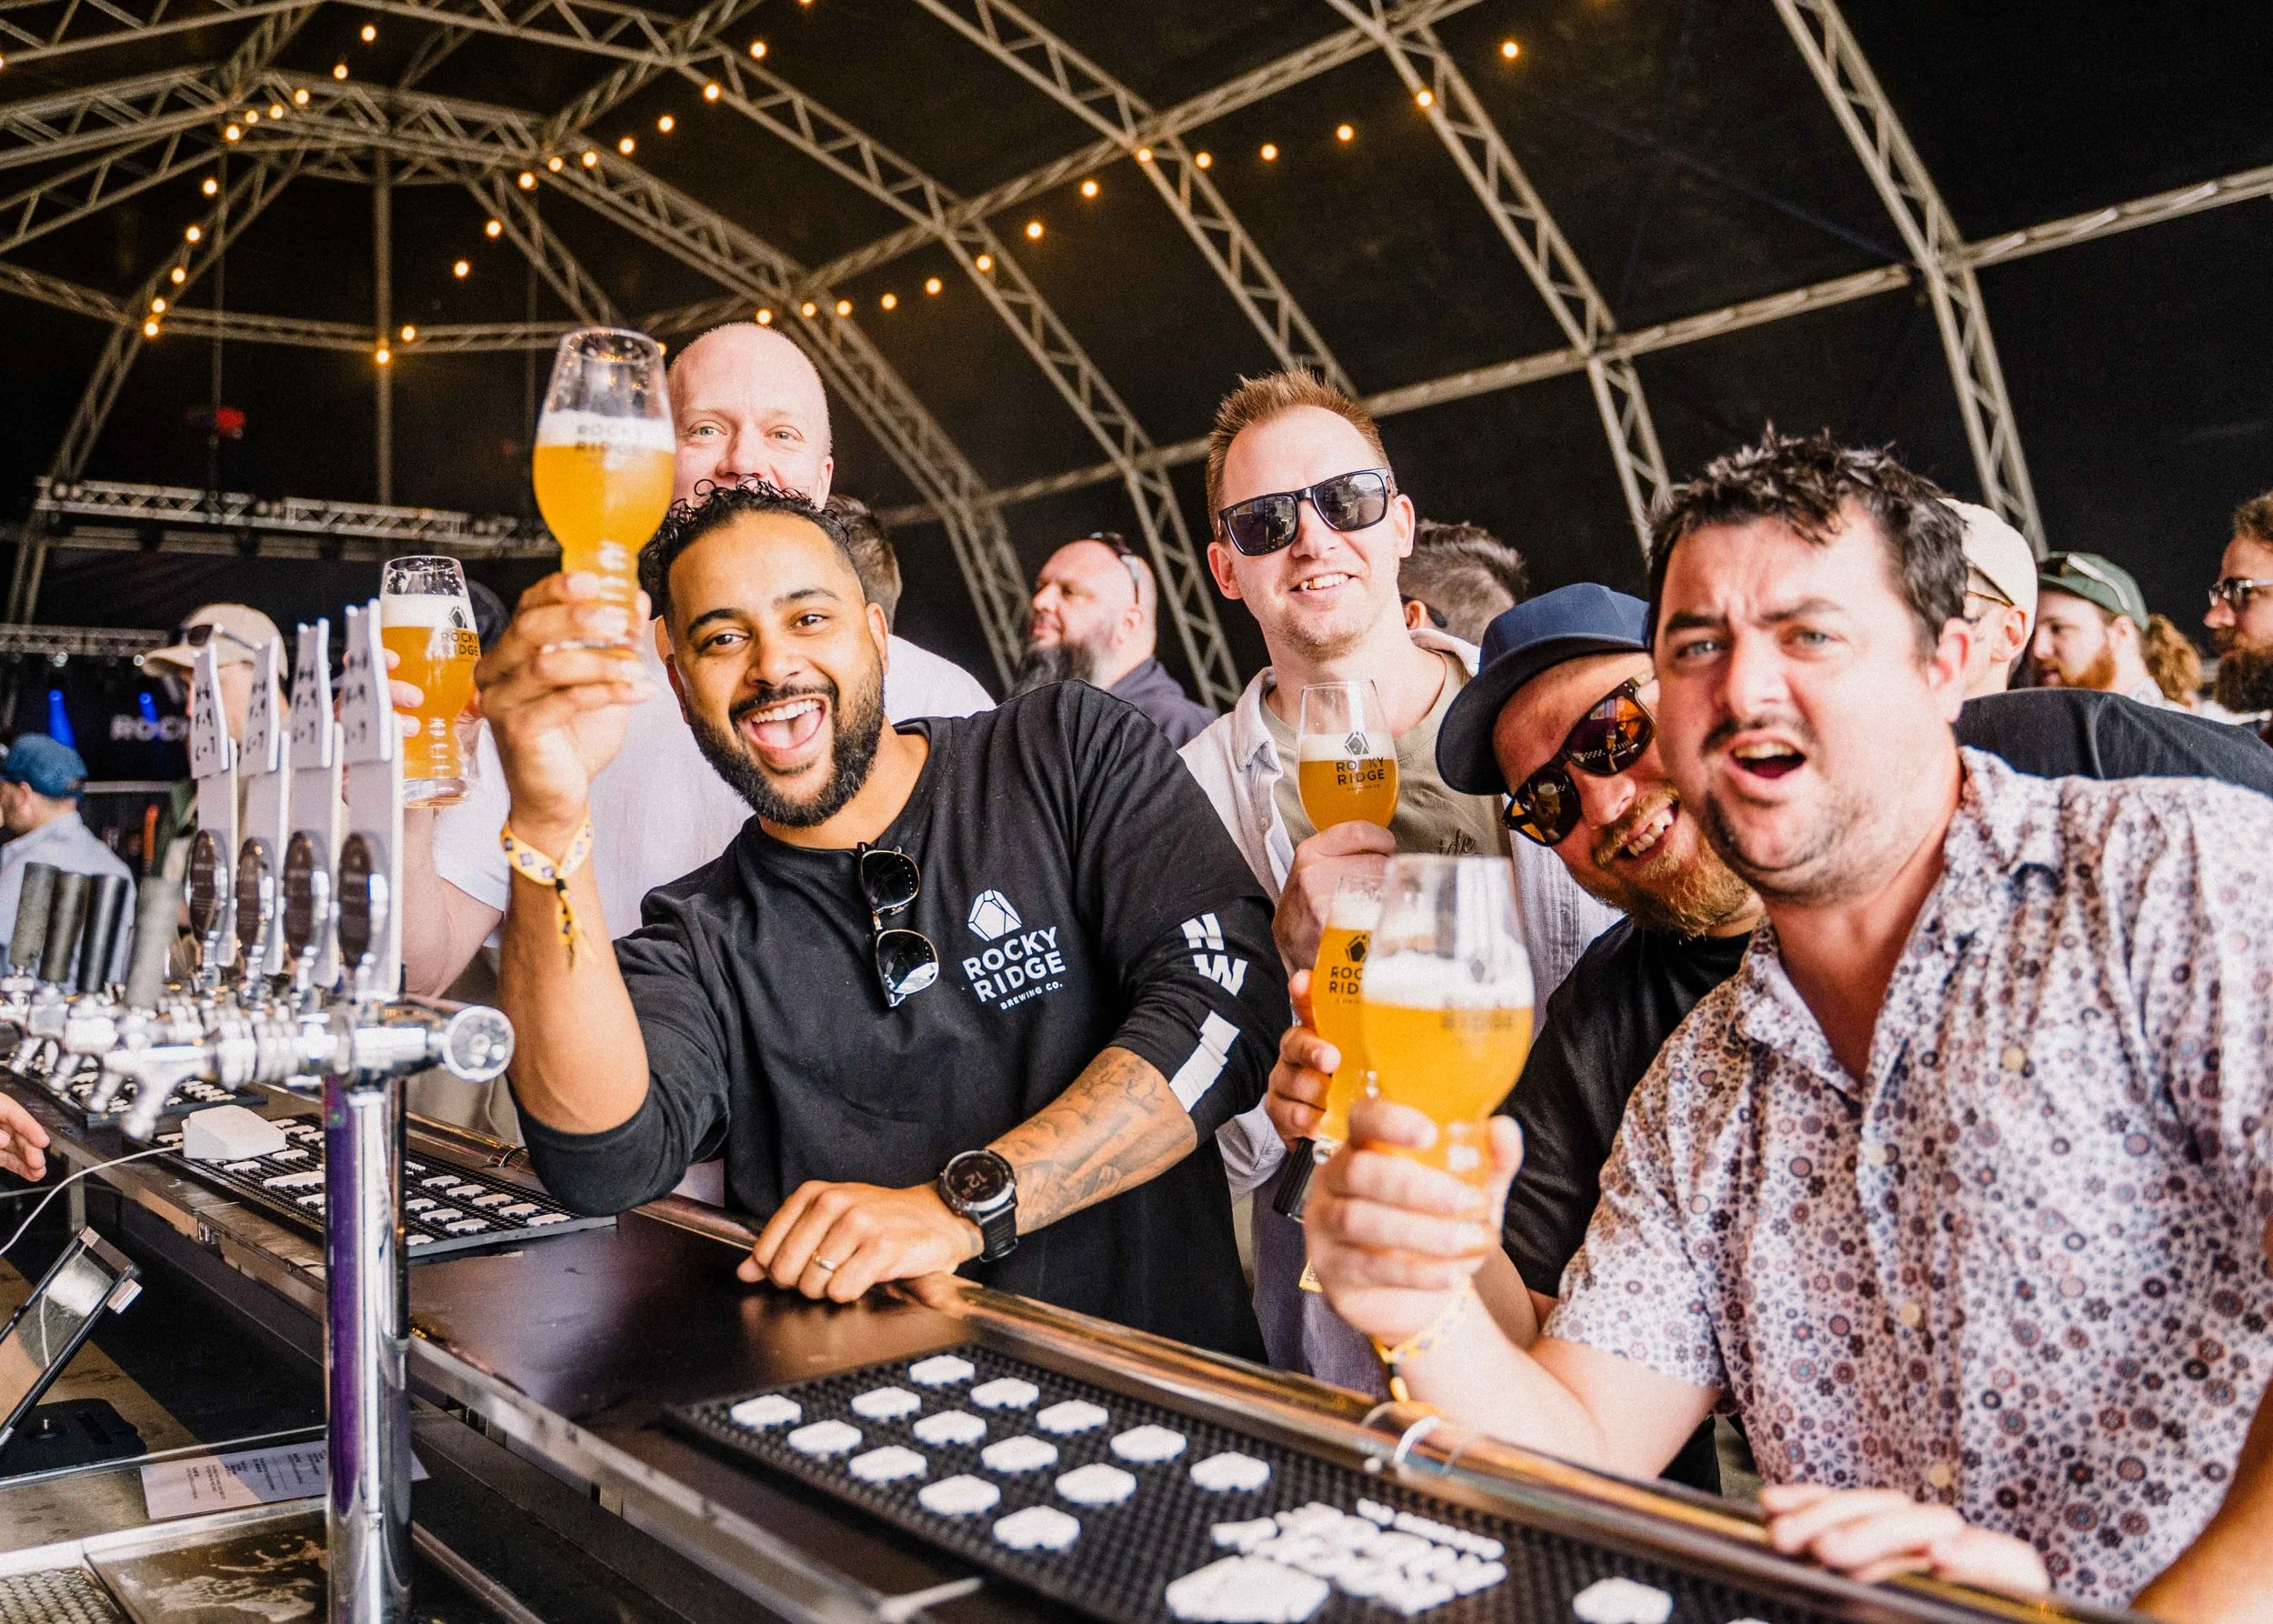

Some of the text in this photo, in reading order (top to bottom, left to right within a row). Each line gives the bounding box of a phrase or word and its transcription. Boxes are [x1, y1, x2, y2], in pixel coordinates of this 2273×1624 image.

[110, 714, 189, 742] ROC
[1337, 768, 1385, 786] RIDGE
[962, 926, 1056, 981] ROCKY
[973, 950, 1066, 1003] RIDGE
[1330, 966, 1363, 980] ROC
[1000, 980, 1064, 1010] BREWING CO.
[1328, 981, 1359, 995] RID
